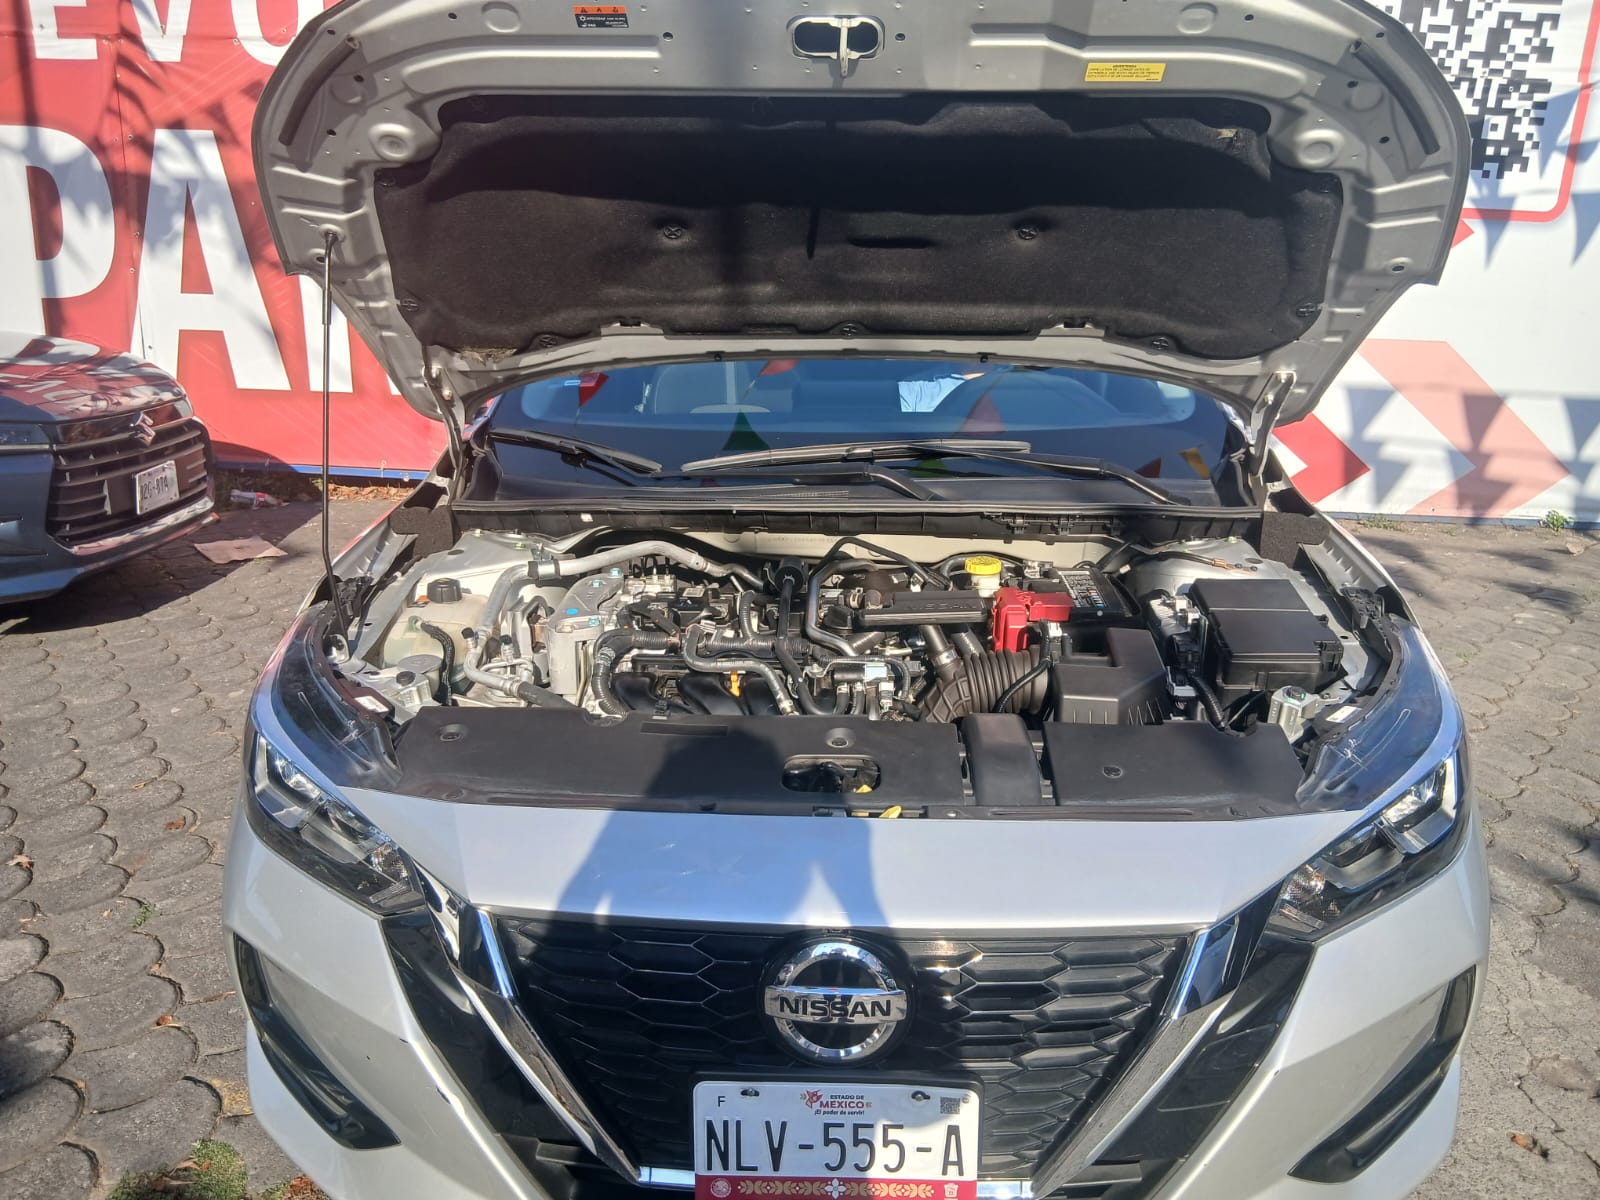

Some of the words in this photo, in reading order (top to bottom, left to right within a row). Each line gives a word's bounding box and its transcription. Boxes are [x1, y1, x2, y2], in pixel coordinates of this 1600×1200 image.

[779, 996, 891, 1018] NISSAN
[717, 1095, 726, 1107] F
[706, 1119, 965, 1177] NLV-555-A
